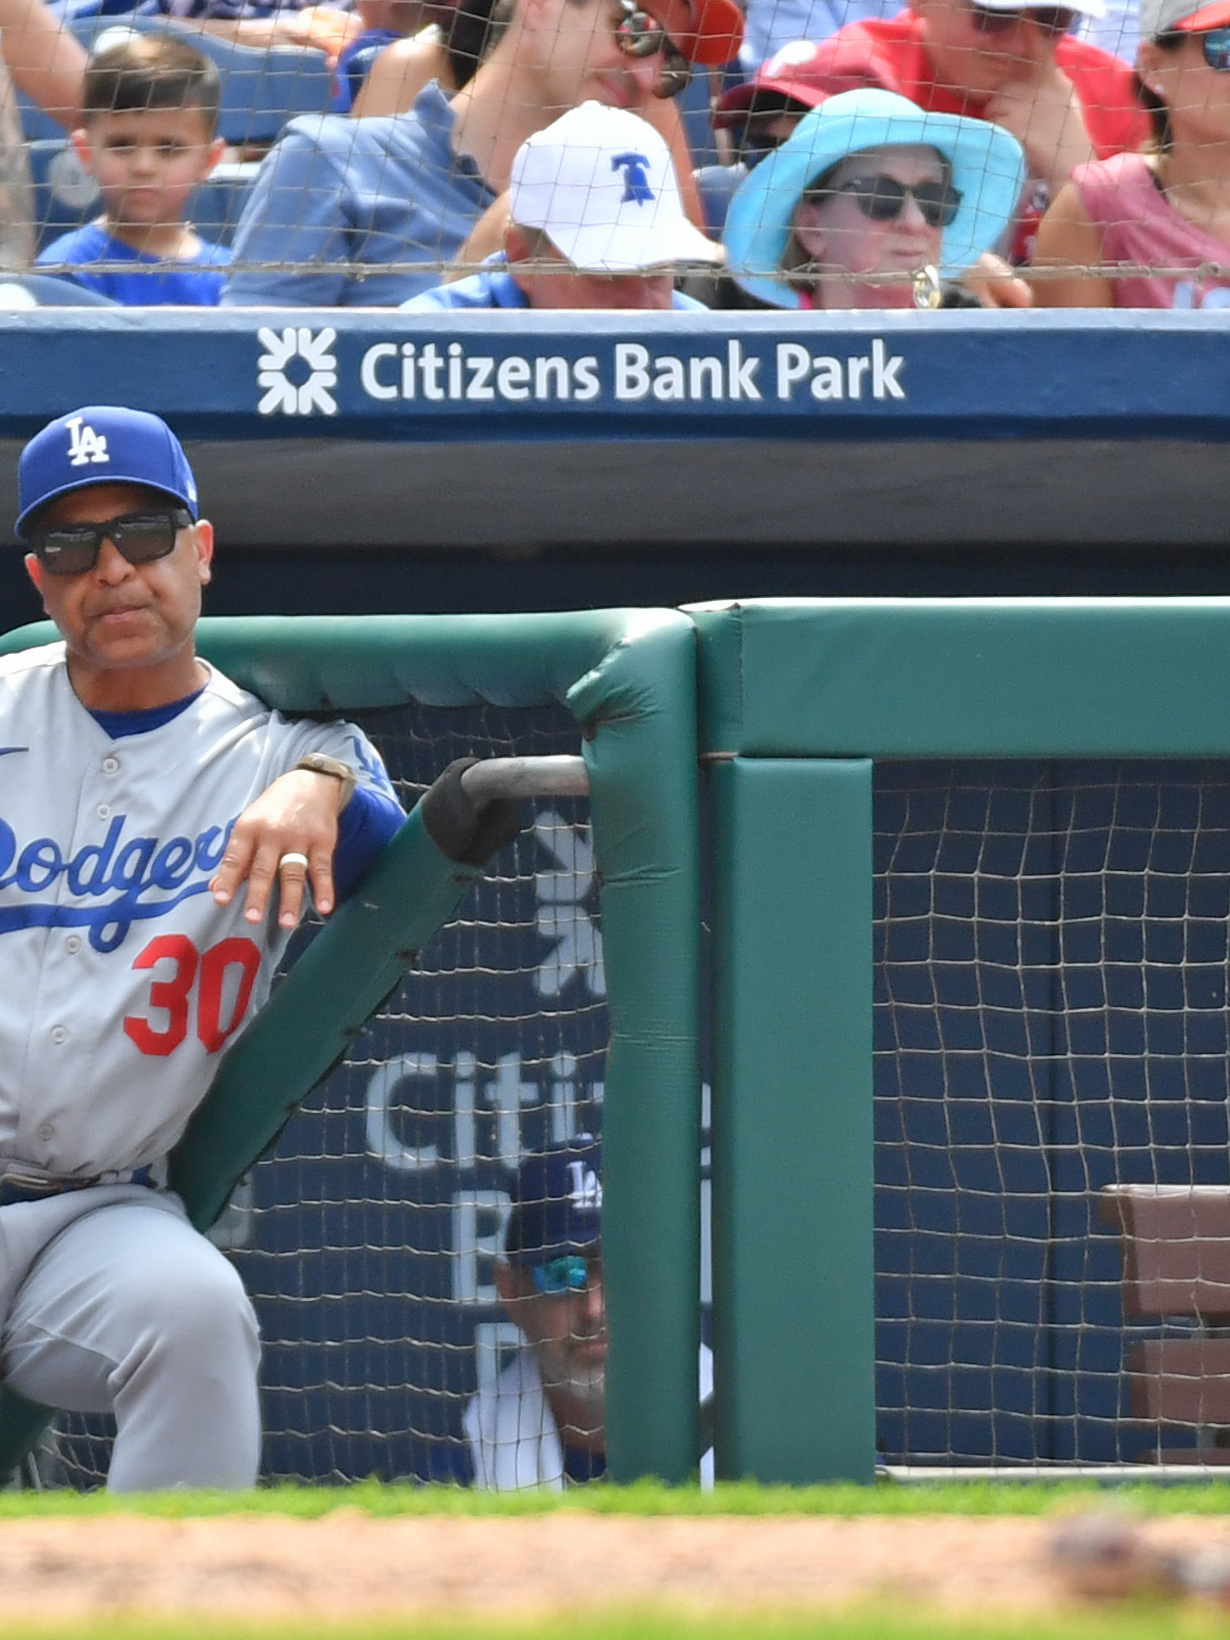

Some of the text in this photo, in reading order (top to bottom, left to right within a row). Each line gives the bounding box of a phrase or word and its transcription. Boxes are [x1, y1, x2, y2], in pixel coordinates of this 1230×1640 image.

[360, 338, 906, 400] Citizens Bank Park
[65, 416, 111, 467] LA
[123, 933, 263, 1057] 30
[365, 1050, 604, 1171] Citi
